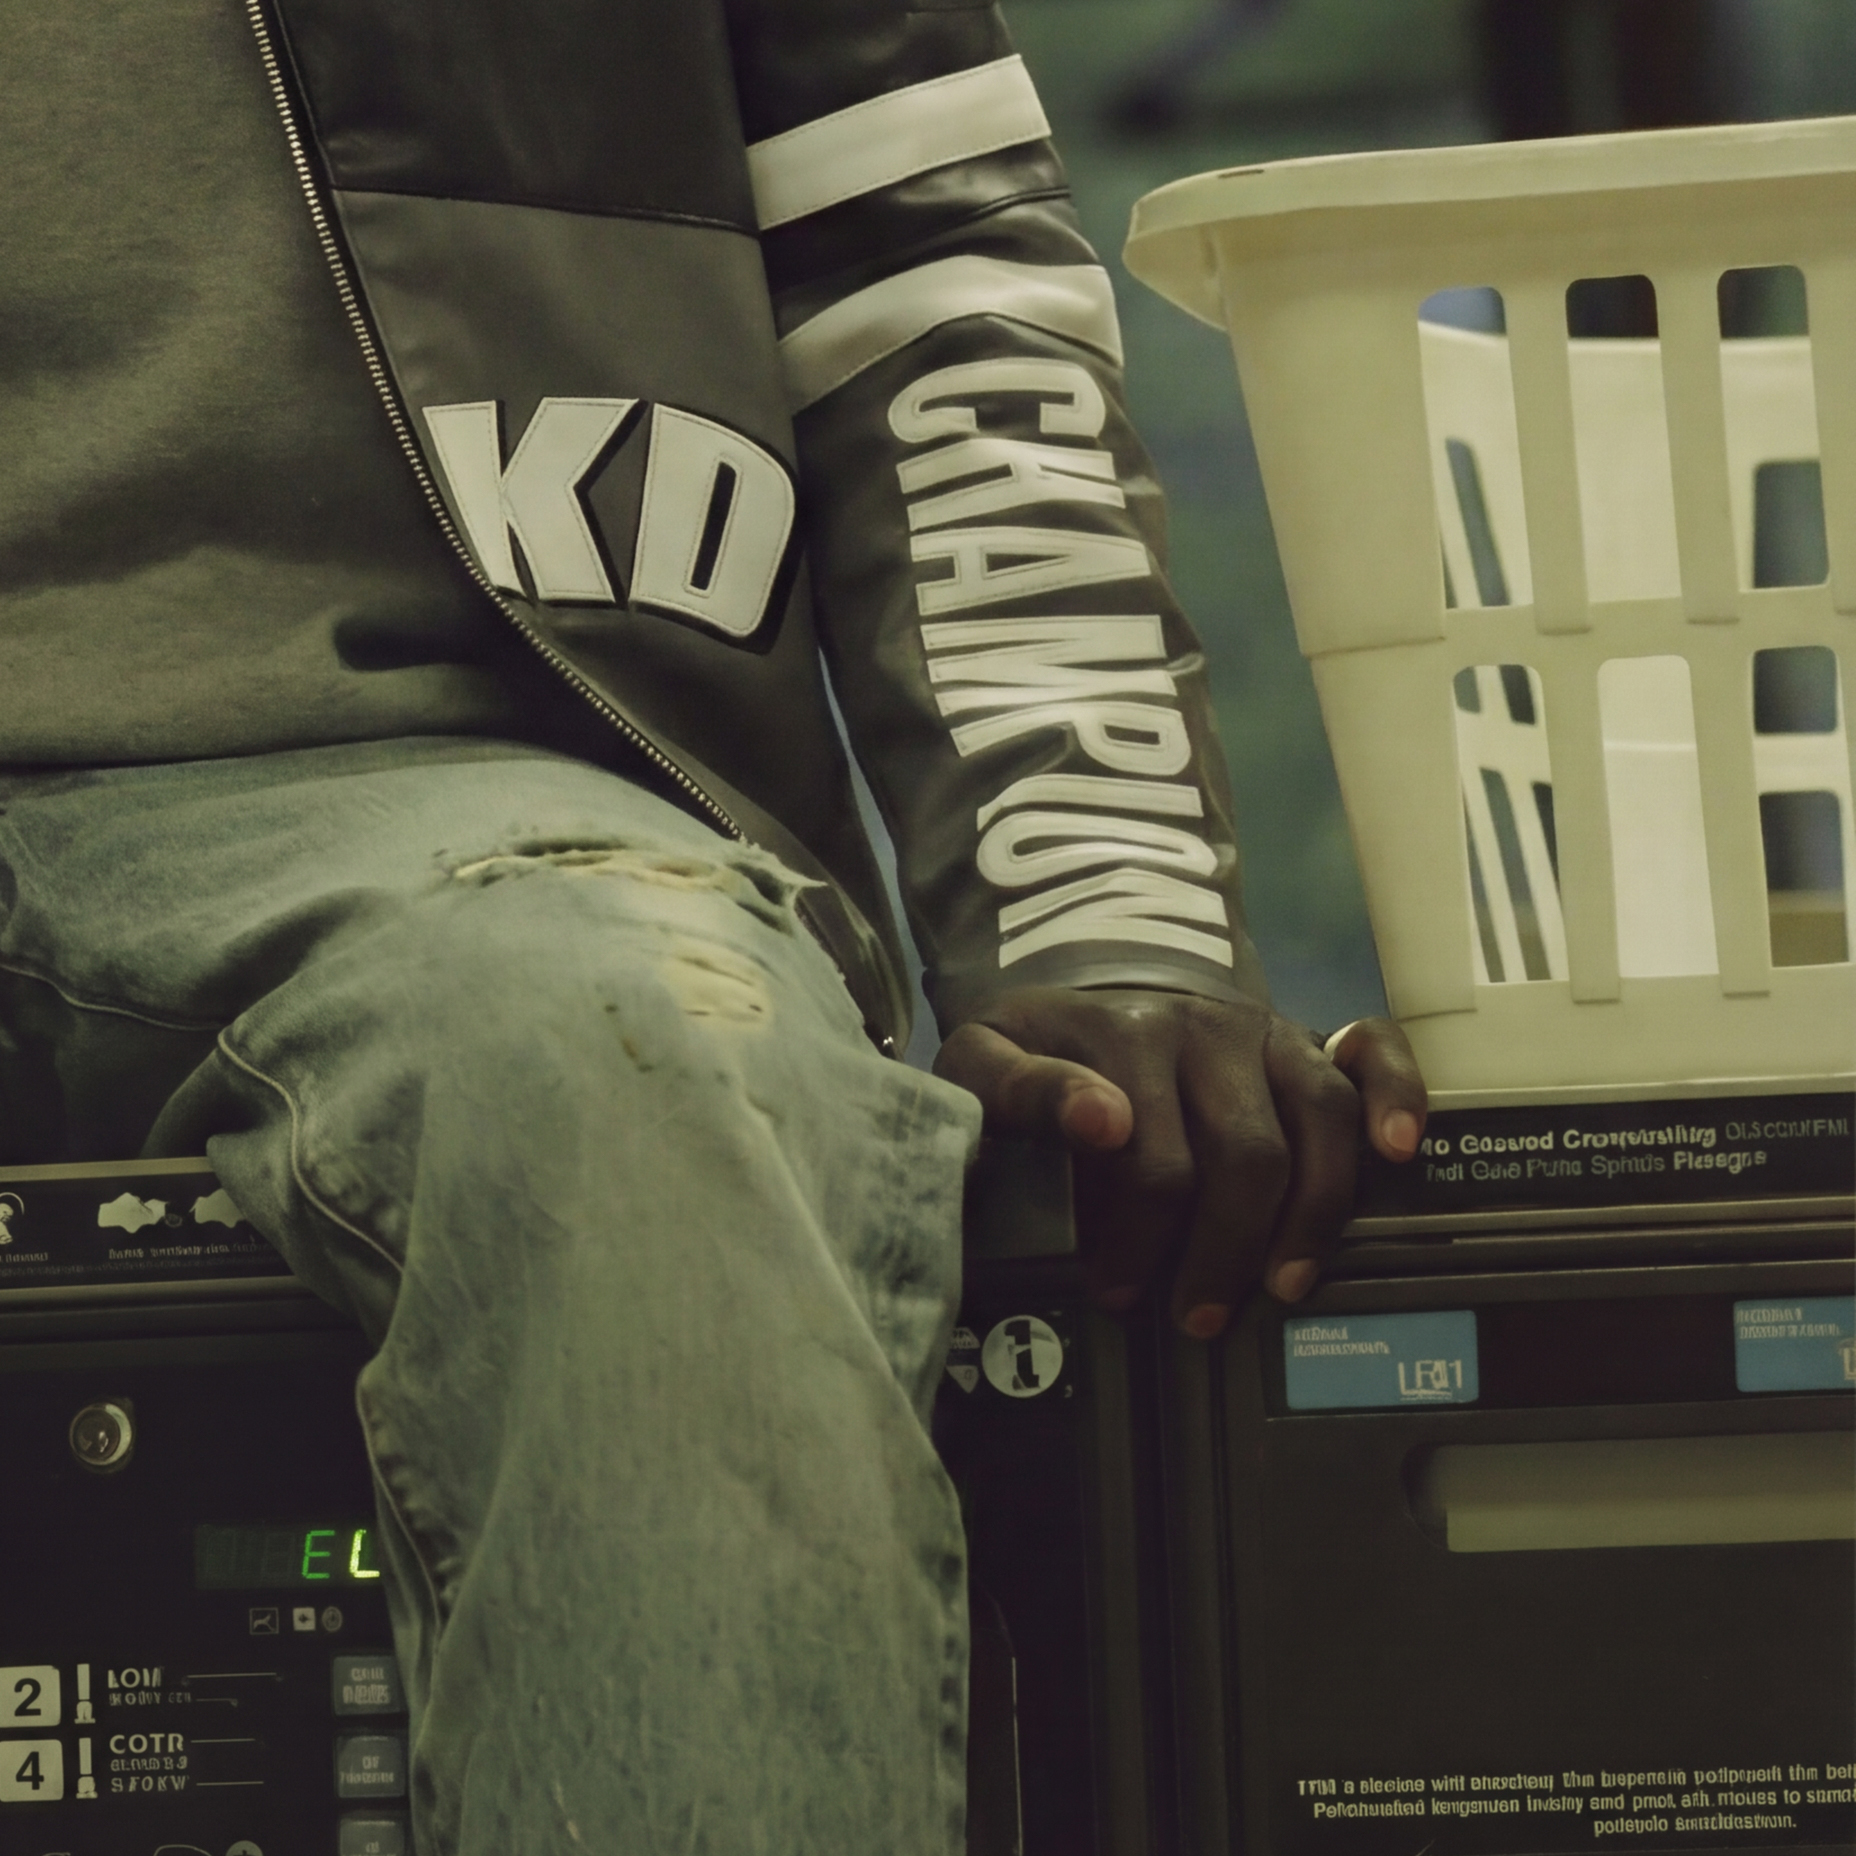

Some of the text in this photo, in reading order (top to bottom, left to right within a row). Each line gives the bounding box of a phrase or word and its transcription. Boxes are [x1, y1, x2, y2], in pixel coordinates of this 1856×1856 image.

[422, 397, 795, 637] KD
[888, 357, 1234, 969] CHAMPION
[14, 1677, 42, 1717] 2
[15, 1751, 45, 1790] 4
